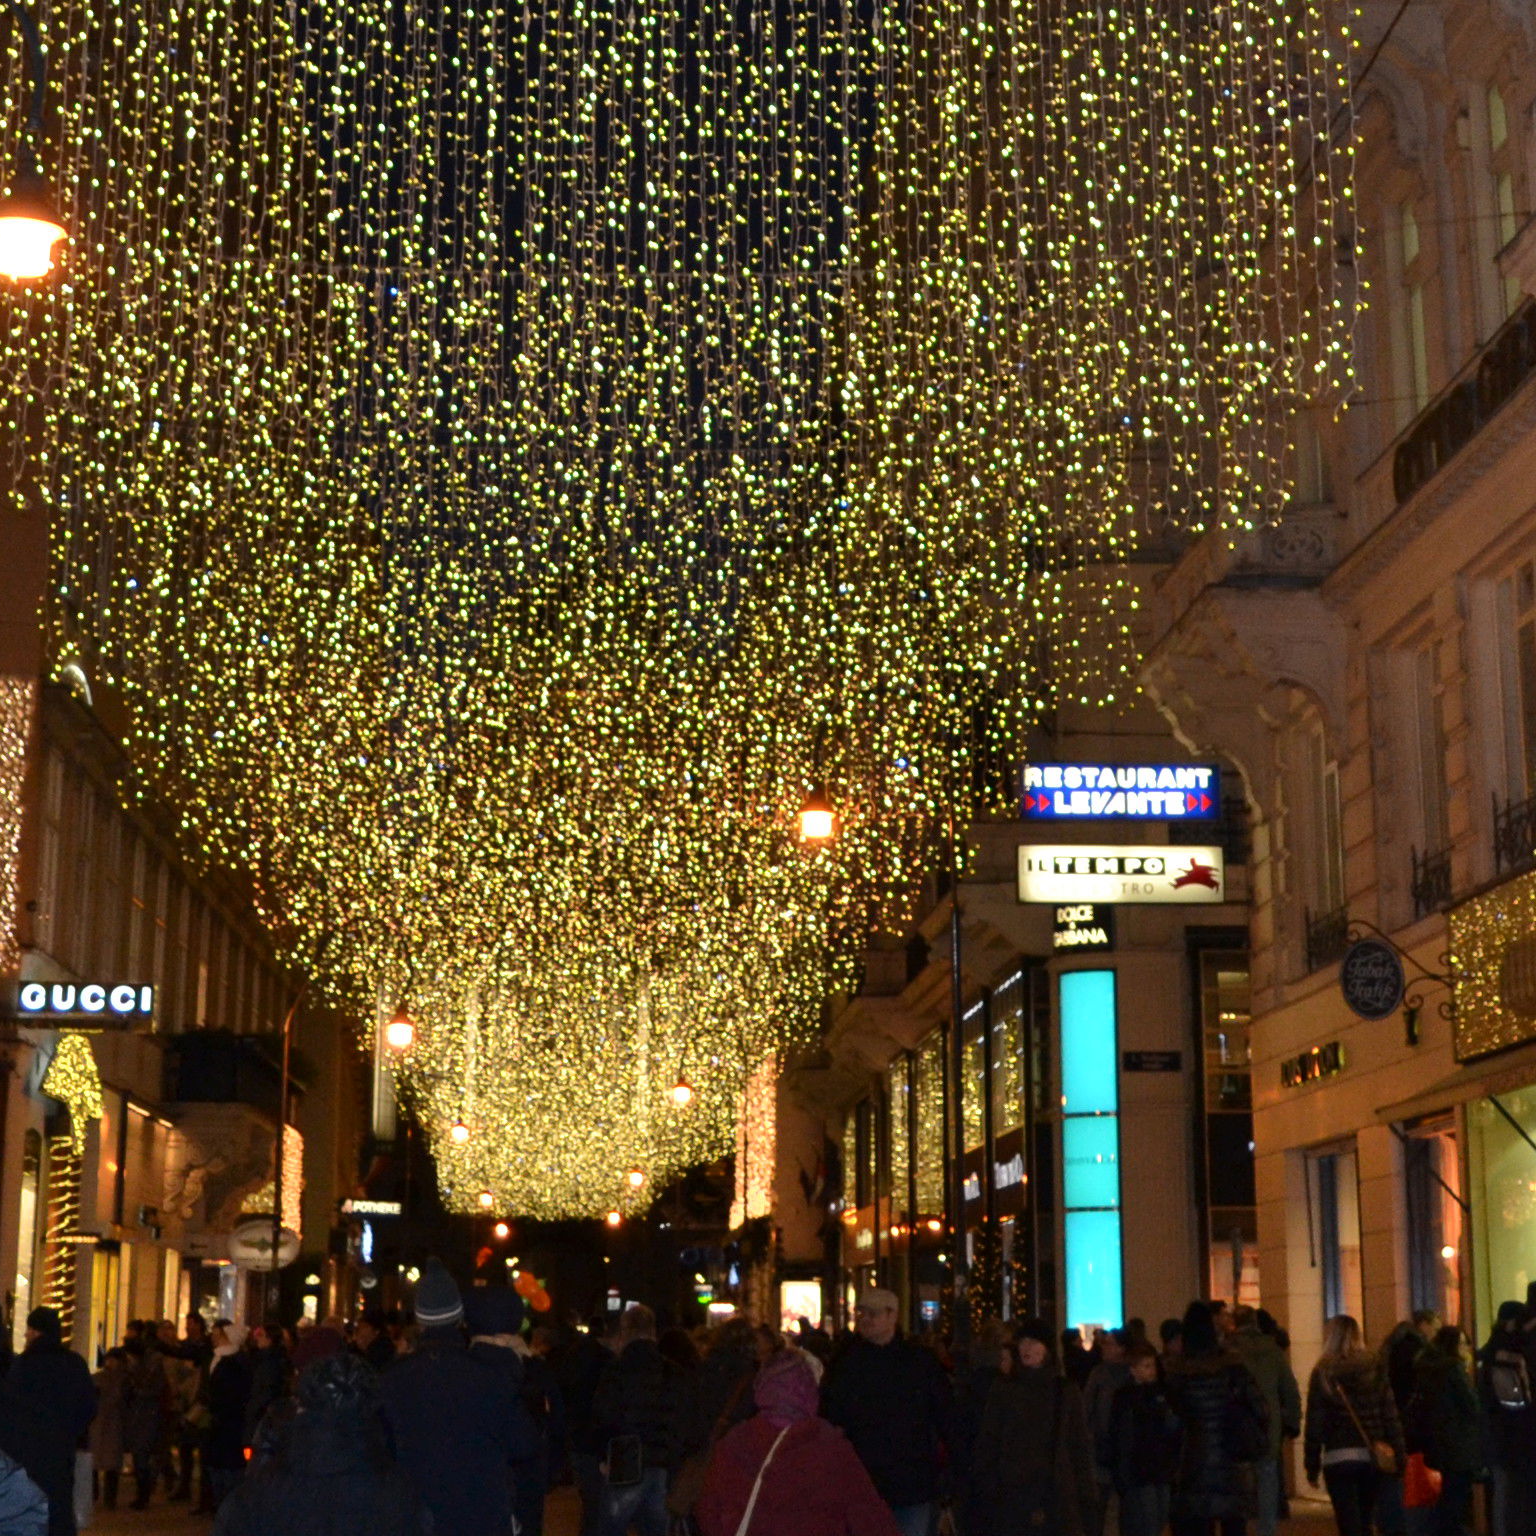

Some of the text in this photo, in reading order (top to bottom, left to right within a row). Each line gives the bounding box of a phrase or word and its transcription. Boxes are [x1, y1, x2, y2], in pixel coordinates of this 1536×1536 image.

[1024, 766, 1213, 789] RESTAURANT
[1054, 791, 1186, 815] LEVANTE
[1054, 857, 1165, 874] TEMPO
[1057, 904, 1094, 923] DOLCE
[20, 982, 153, 1013] GUCCI
